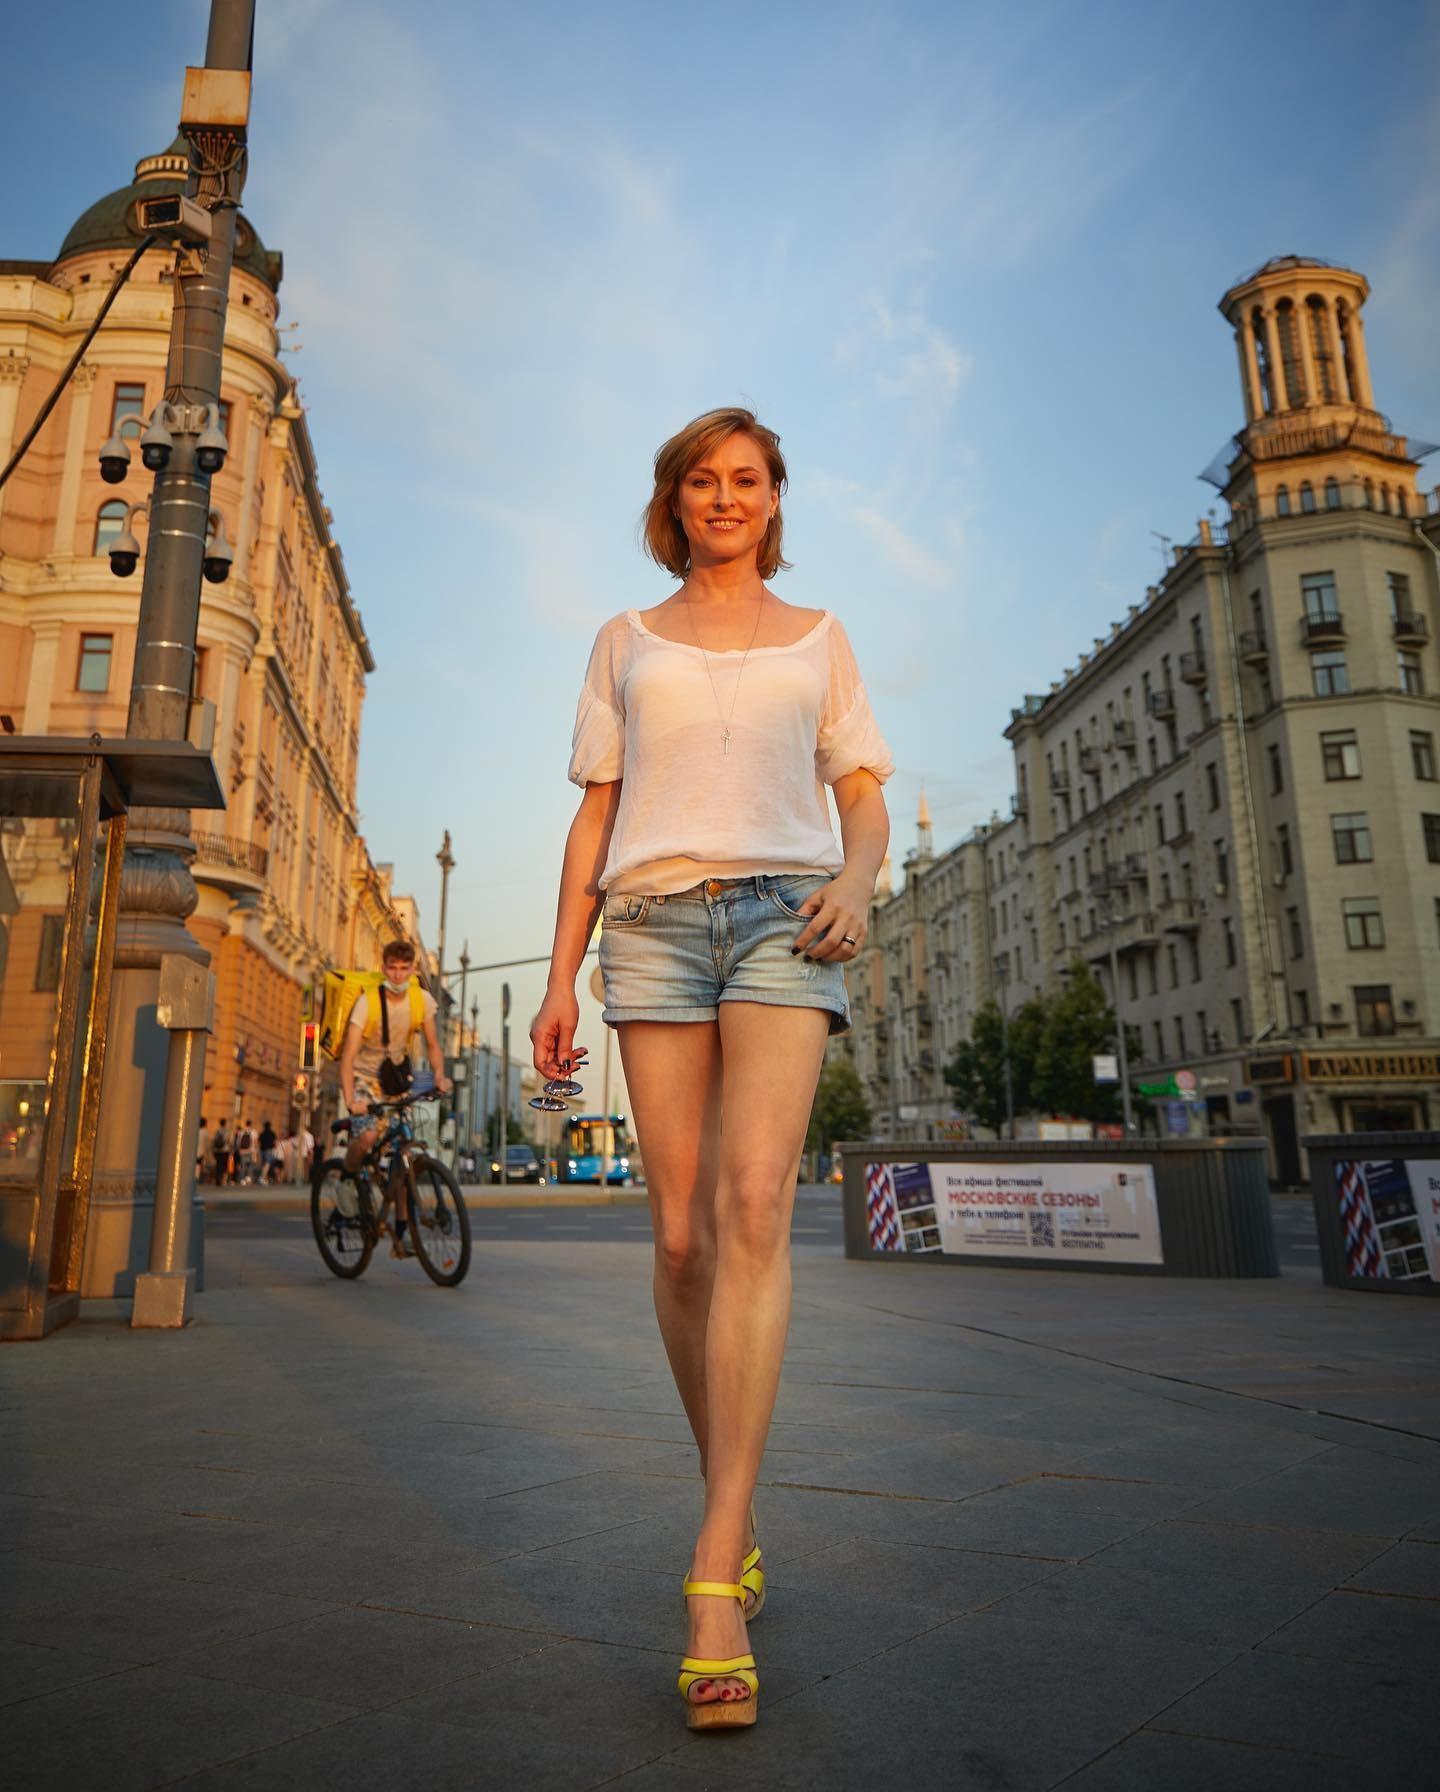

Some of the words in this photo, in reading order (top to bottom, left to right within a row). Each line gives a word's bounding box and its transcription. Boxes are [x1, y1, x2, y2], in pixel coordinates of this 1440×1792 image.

[1318, 1055, 1437, 1075] АРМЕНИЯ
[948, 1191, 1038, 1205] МОСКОВСКИЕ
[1042, 1193, 1100, 1207] СЕЗОНЫ
